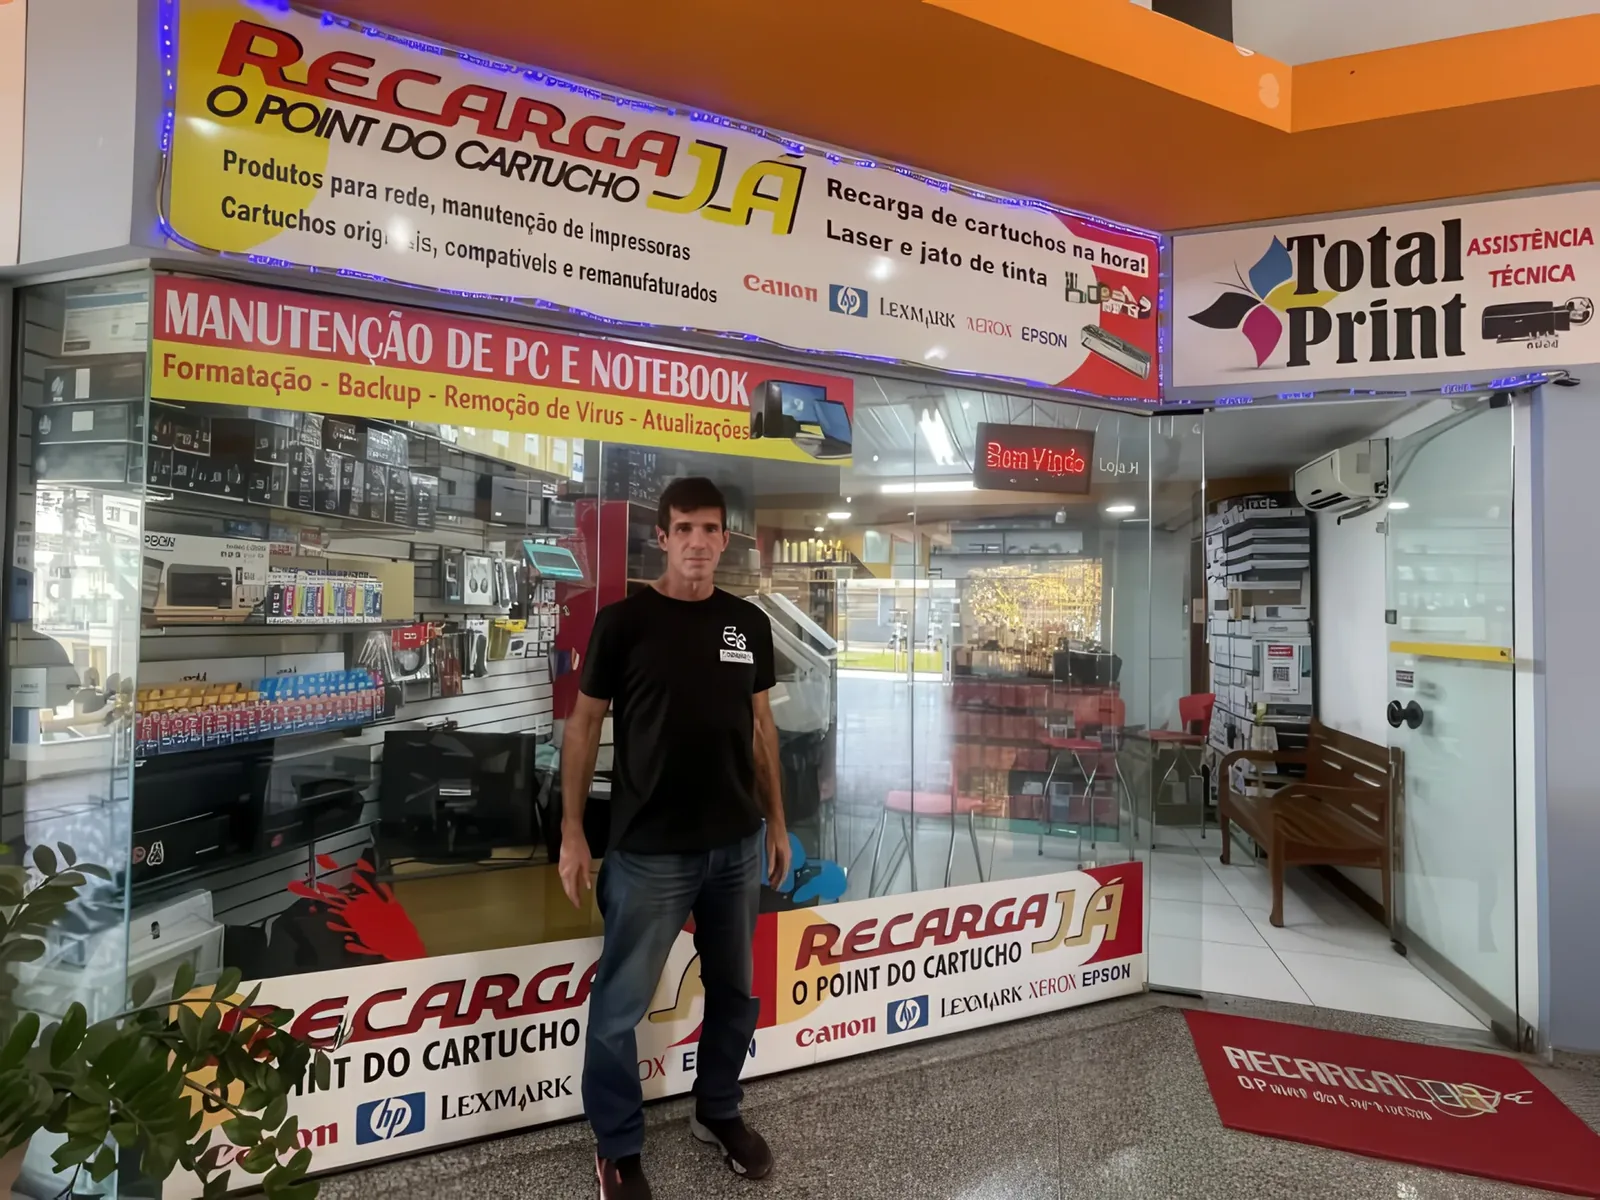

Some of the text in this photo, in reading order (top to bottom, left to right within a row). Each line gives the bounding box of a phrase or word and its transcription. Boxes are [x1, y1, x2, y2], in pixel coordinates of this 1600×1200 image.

[217, 20, 681, 178] RECARGA
[206, 85, 641, 203] O POINT DO CARTUCHO
[223, 149, 691, 261] Produtos para rede, manutenção de impressoras
[826, 178, 1146, 274] Recarga de cartuchos na hora!
[1466, 227, 1595, 256] ASSISTÊNCIA
[221, 195, 337, 236] Cartuchos
[344, 220, 438, 259] origis,
[563, 262, 573, 278] e
[579, 264, 717, 303] remanufaturados
[826, 219, 1048, 287] Laser e jato de tinta
[1286, 218, 1465, 296] Total
[1488, 263, 1576, 288] TÉCNICA
[165, 289, 750, 406] MANUTENÇÃO DE PC E NOTEBOOK
[880, 297, 956, 329] LEXMARK
[1021, 327, 1067, 348] EPSON
[1286, 293, 1467, 368] Print
[163, 353, 312, 396] Formatação
[338, 372, 421, 409] Backup
[445, 385, 540, 420] Remoção
[546, 397, 570, 420] de
[642, 409, 750, 442] Atualizações
[795, 877, 1124, 971] RECARGA JÁ
[792, 941, 1022, 1005] O POINT DO CARTUCHO
[795, 1016, 876, 1047] Canon
[941, 985, 1023, 1018] LEXMARK
[1029, 974, 1077, 999] XEROX
[1082, 963, 1131, 987] EPSON
[364, 1047, 411, 1083] DO
[422, 1018, 580, 1071] CARTUCHO
[441, 1075, 573, 1120] LEXMARK
